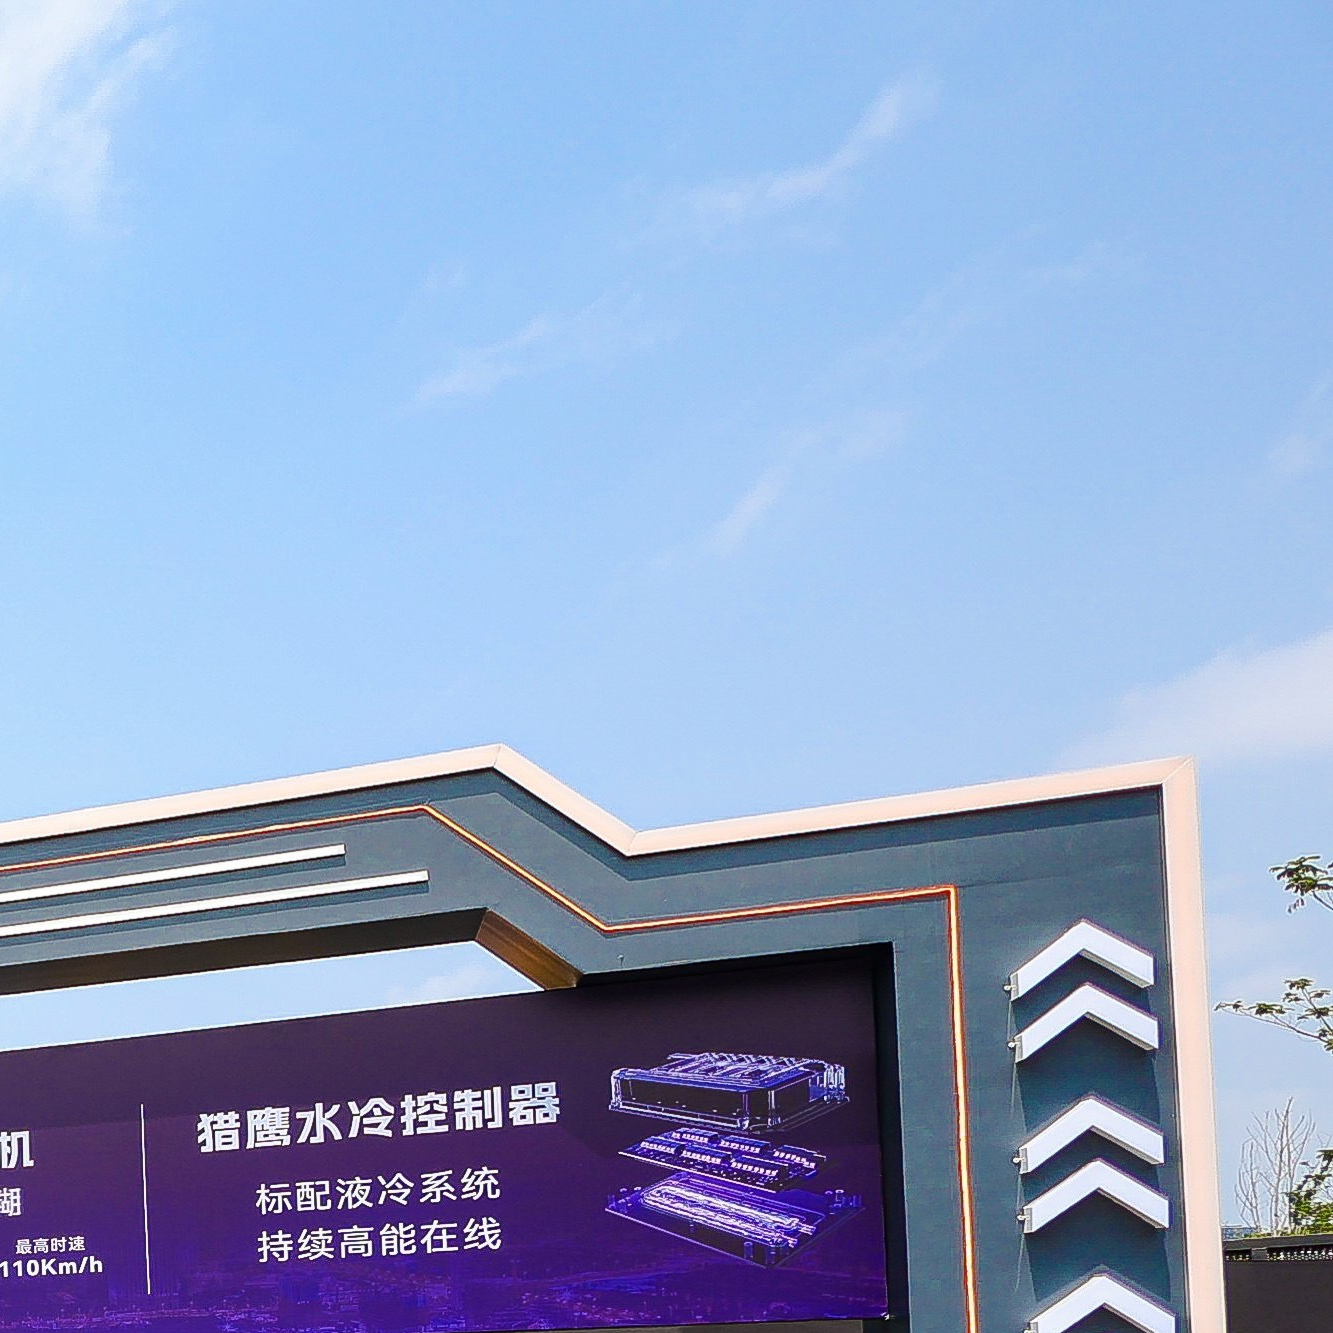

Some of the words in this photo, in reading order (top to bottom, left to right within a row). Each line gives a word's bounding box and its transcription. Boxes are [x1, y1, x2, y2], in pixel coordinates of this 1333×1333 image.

[196, 1082, 560, 1153] 猎鹰水冷控制器
[255, 1165, 502, 1216] 标配液冷系统
[14, 1235, 86, 1256] 最高时速
[256, 1217, 503, 1265] 持续高能在线
